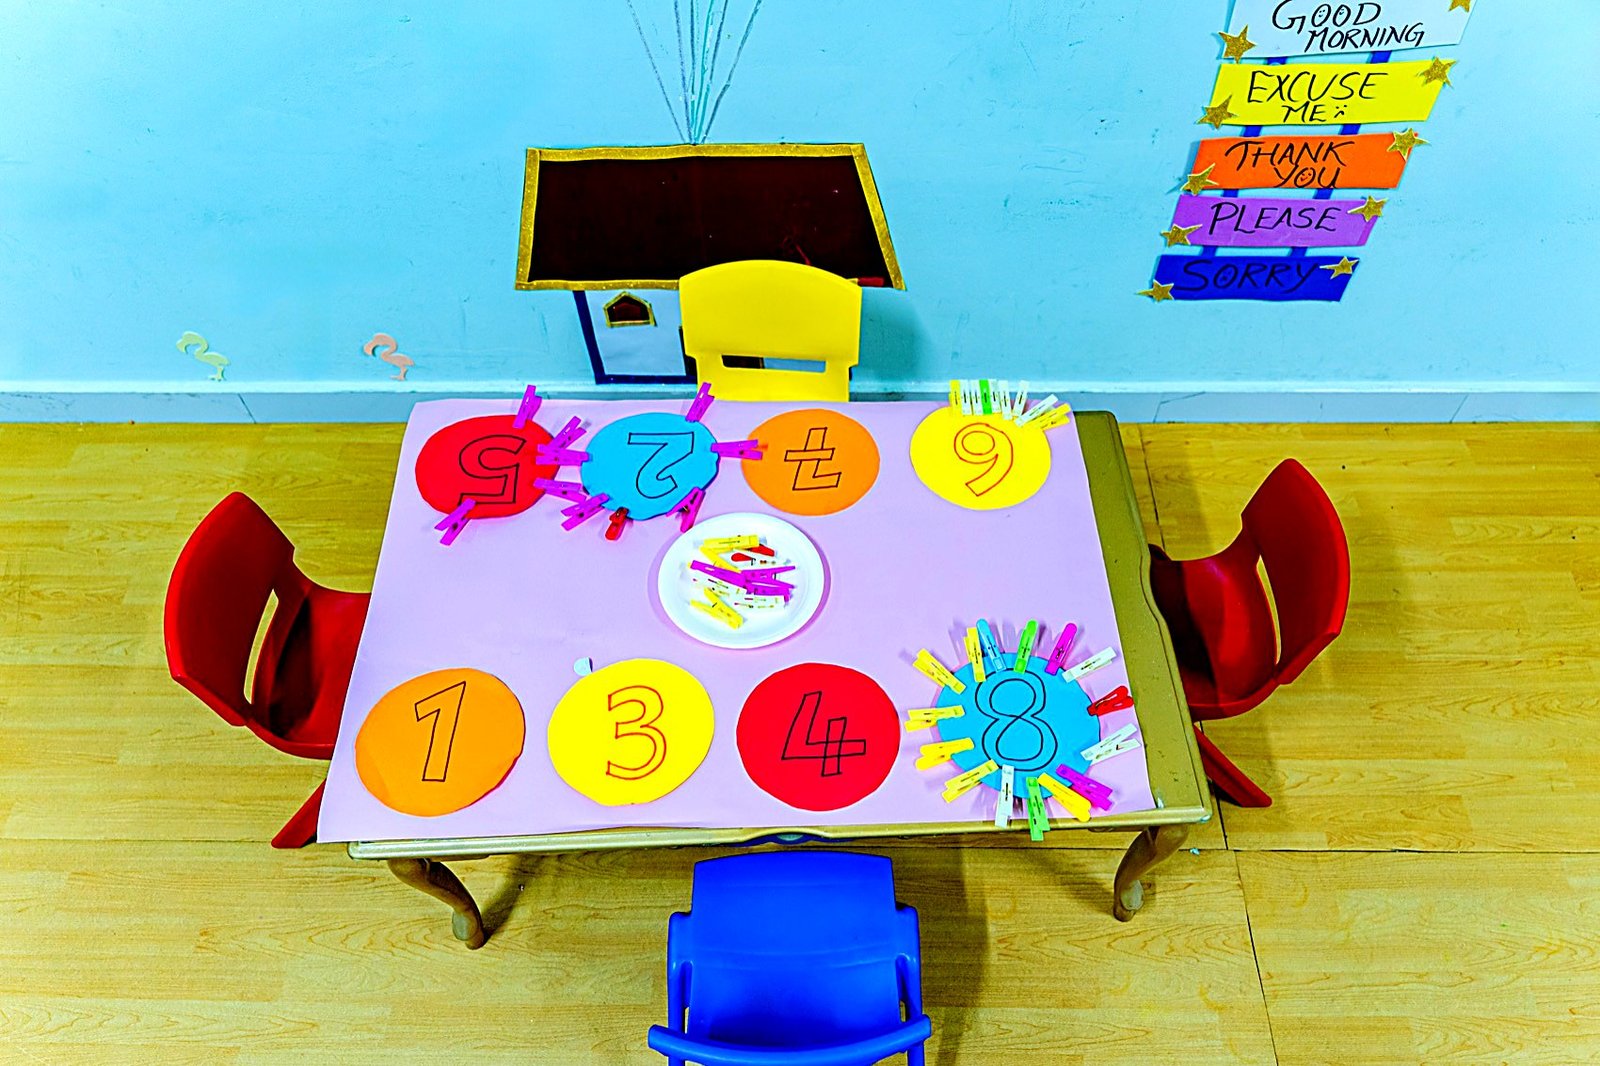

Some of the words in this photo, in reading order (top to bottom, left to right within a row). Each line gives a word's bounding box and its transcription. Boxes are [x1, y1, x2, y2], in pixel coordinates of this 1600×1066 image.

[1272, 0, 1381, 34] GOOD
[1304, 22, 1425, 52] MORNING
[1247, 70, 1388, 103] EXCUSE
[1224, 141, 1355, 171] THANK
[1273, 164, 1341, 189] YOU
[1209, 202, 1342, 235] PLEASE
[1174, 259, 1320, 294] SORRY
[457, 433, 528, 504] 5
[626, 431, 694, 498] 2
[783, 427, 842, 491] 7
[414, 680, 467, 782] 1
[606, 684, 668, 781] 3
[781, 690, 867, 777] 4
[975, 668, 1059, 771] 8
